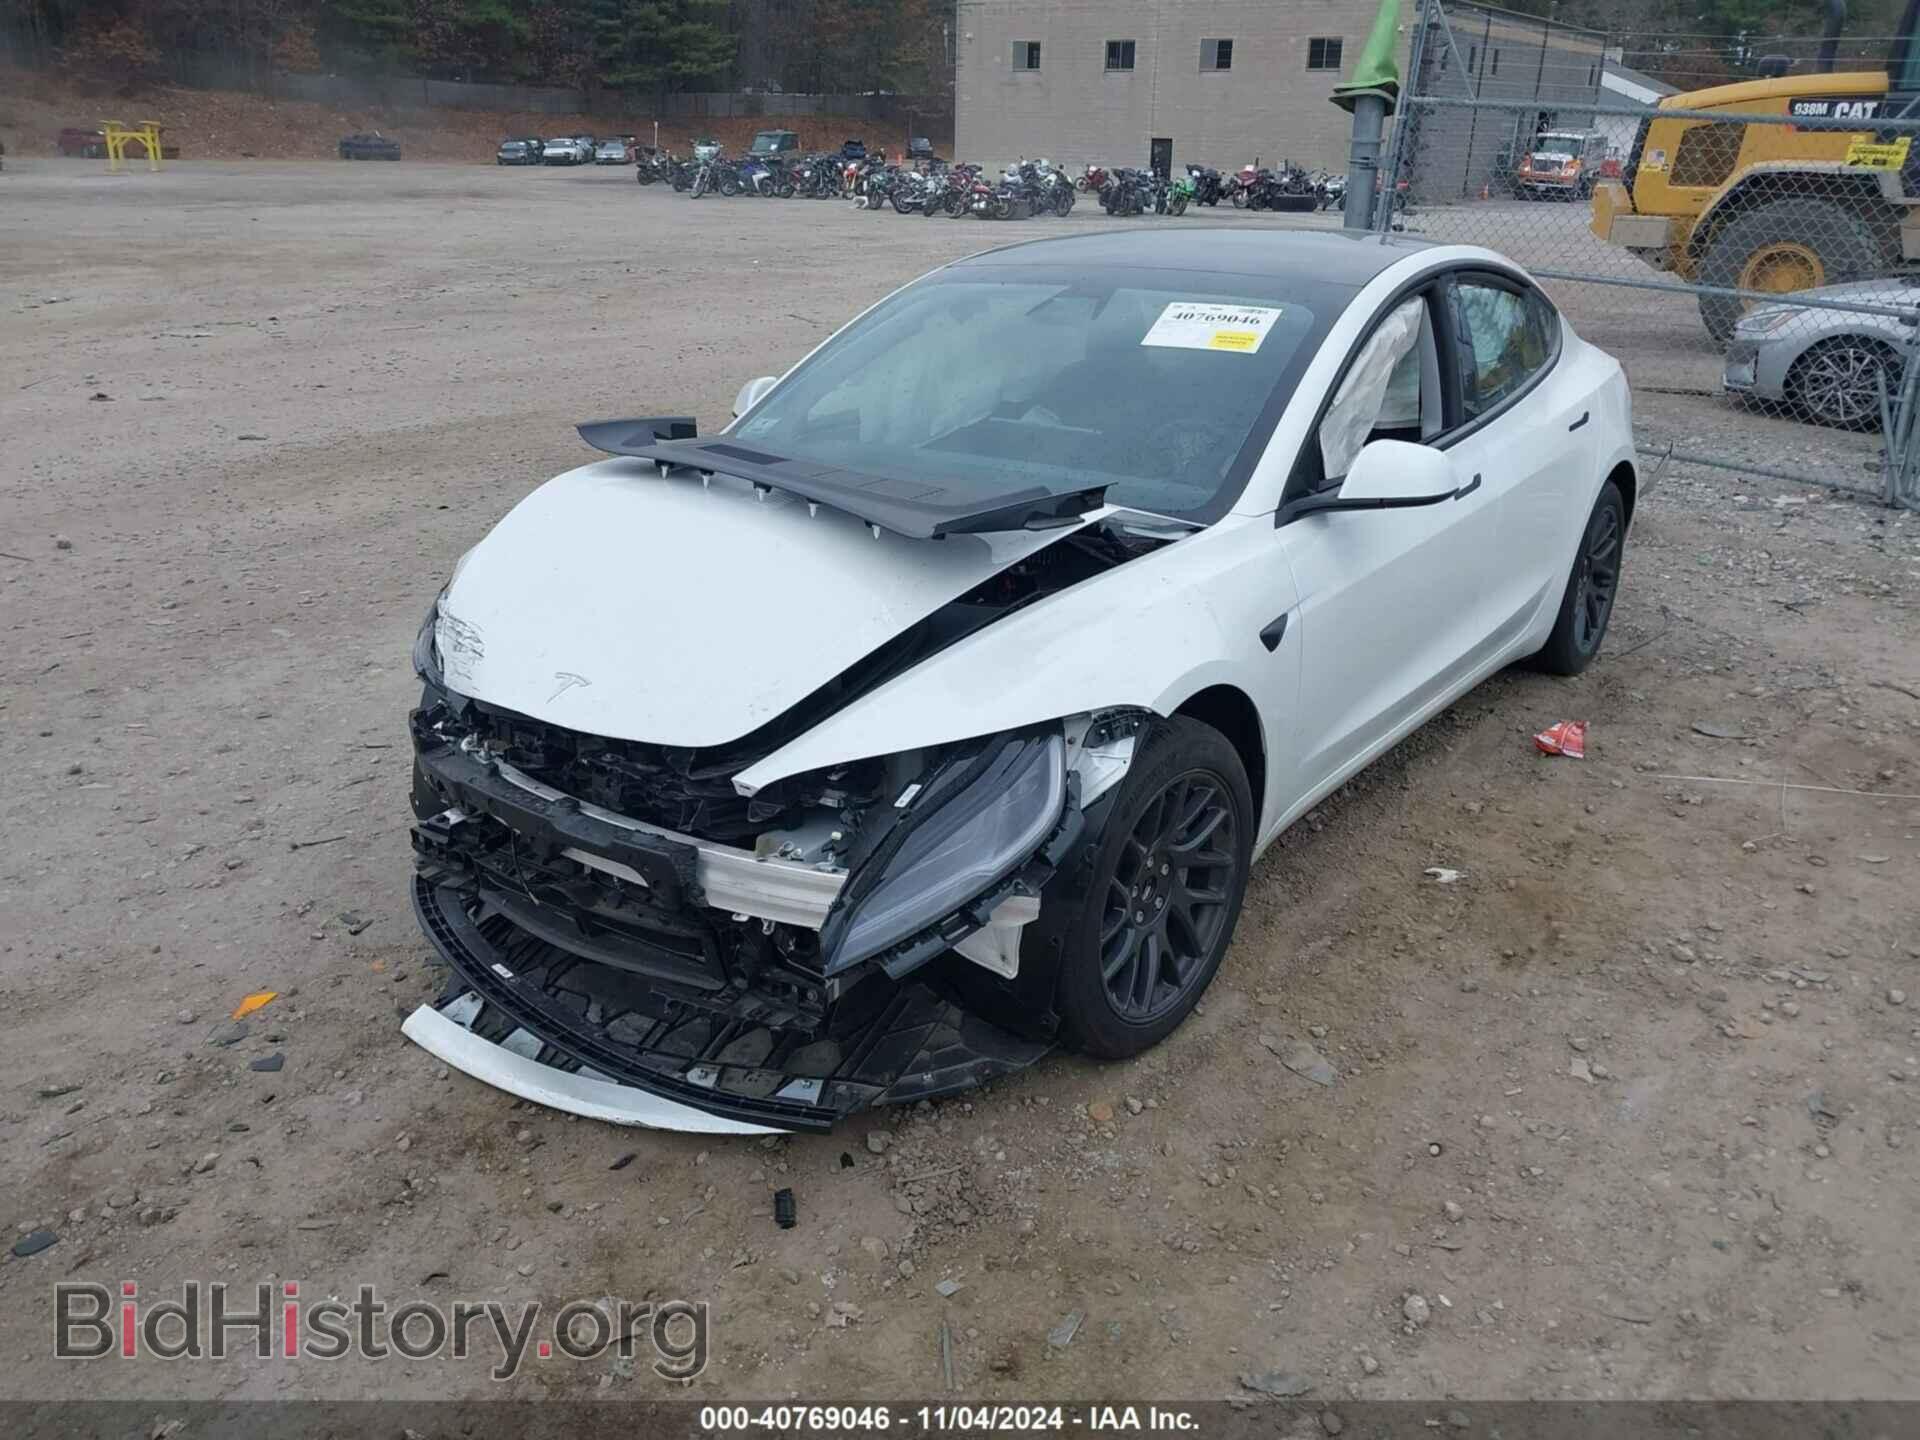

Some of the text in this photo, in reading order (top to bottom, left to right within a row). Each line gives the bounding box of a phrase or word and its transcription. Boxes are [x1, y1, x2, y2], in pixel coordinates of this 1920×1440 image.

[1795, 102, 1877, 119] 938M CAT
[1173, 312, 1260, 324] 40769046
